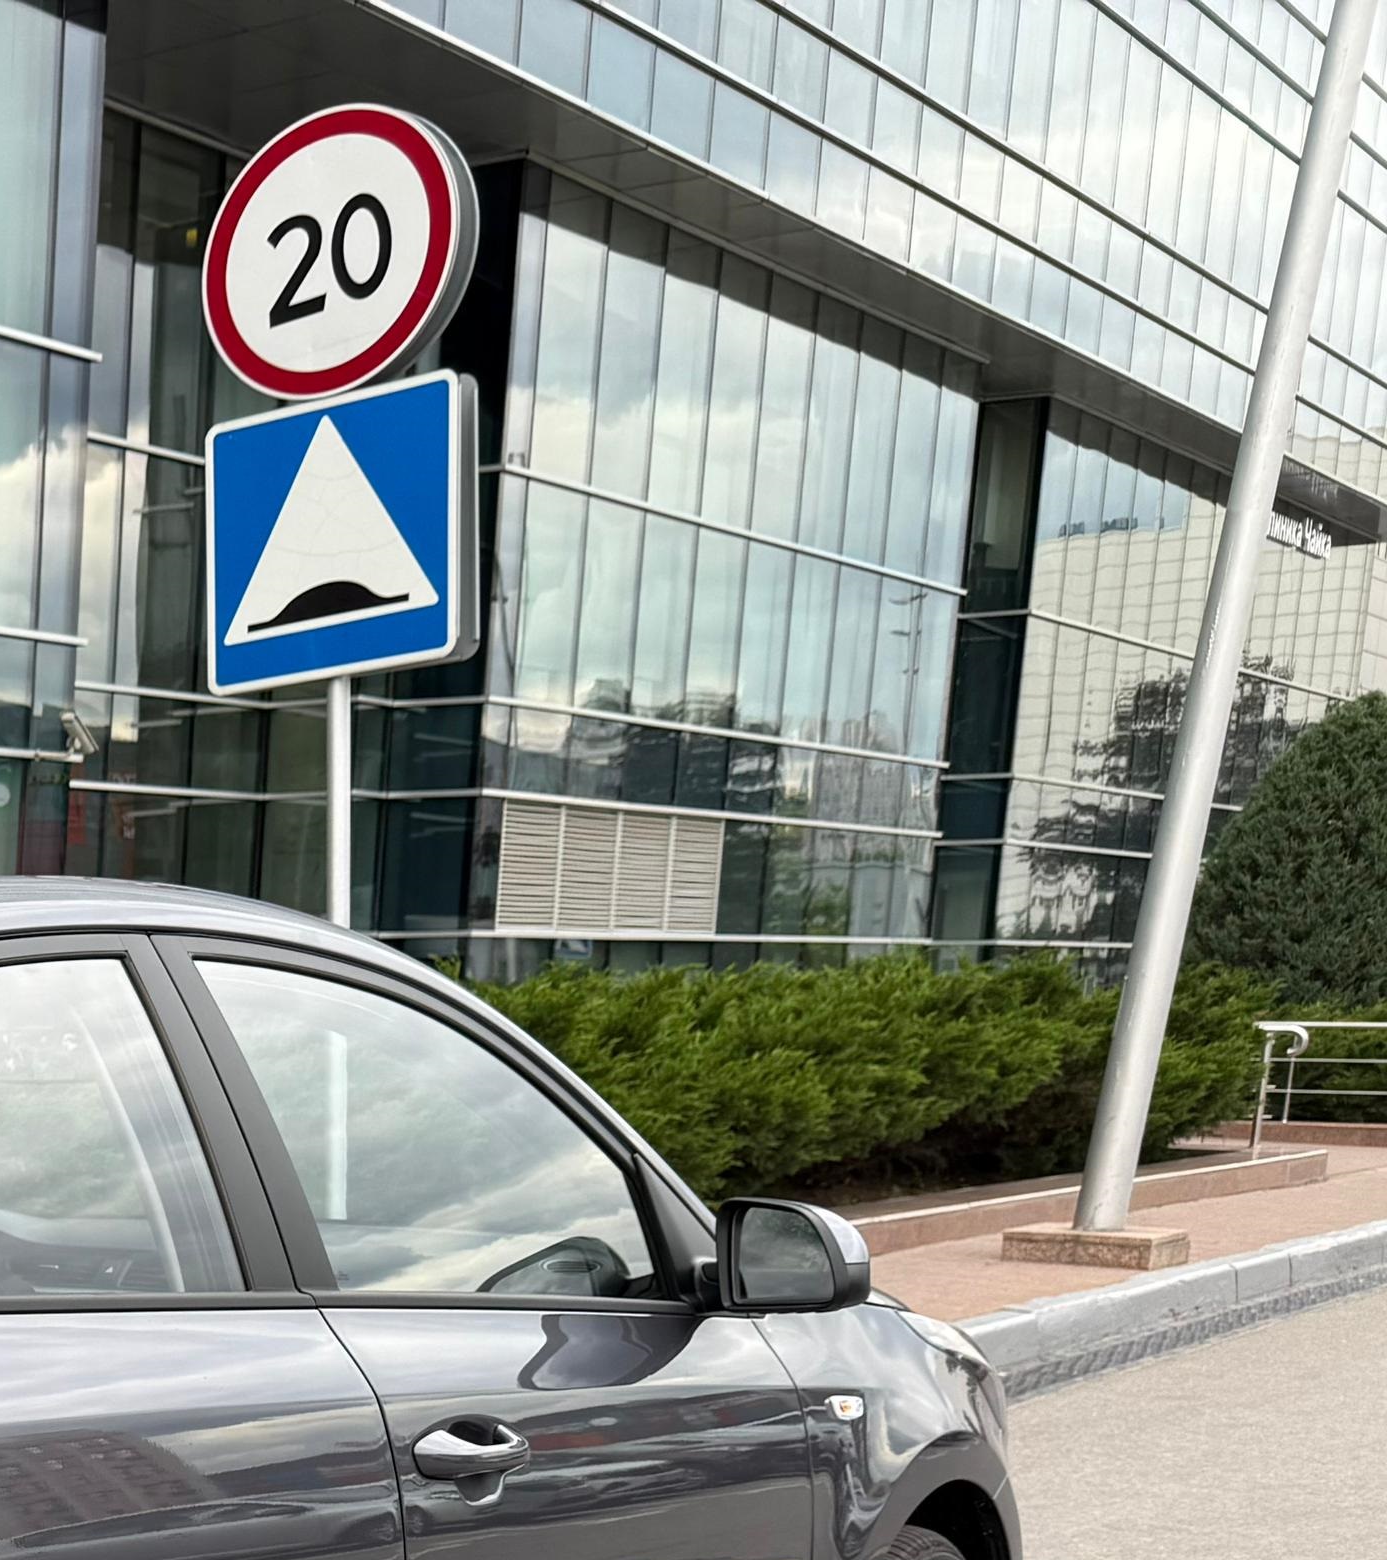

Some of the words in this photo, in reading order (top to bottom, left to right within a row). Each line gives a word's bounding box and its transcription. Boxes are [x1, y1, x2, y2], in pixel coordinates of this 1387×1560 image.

[266, 193, 393, 329] 20
[1267, 511, 1303, 546] линика
[1305, 517, 1332, 559] Чайка
